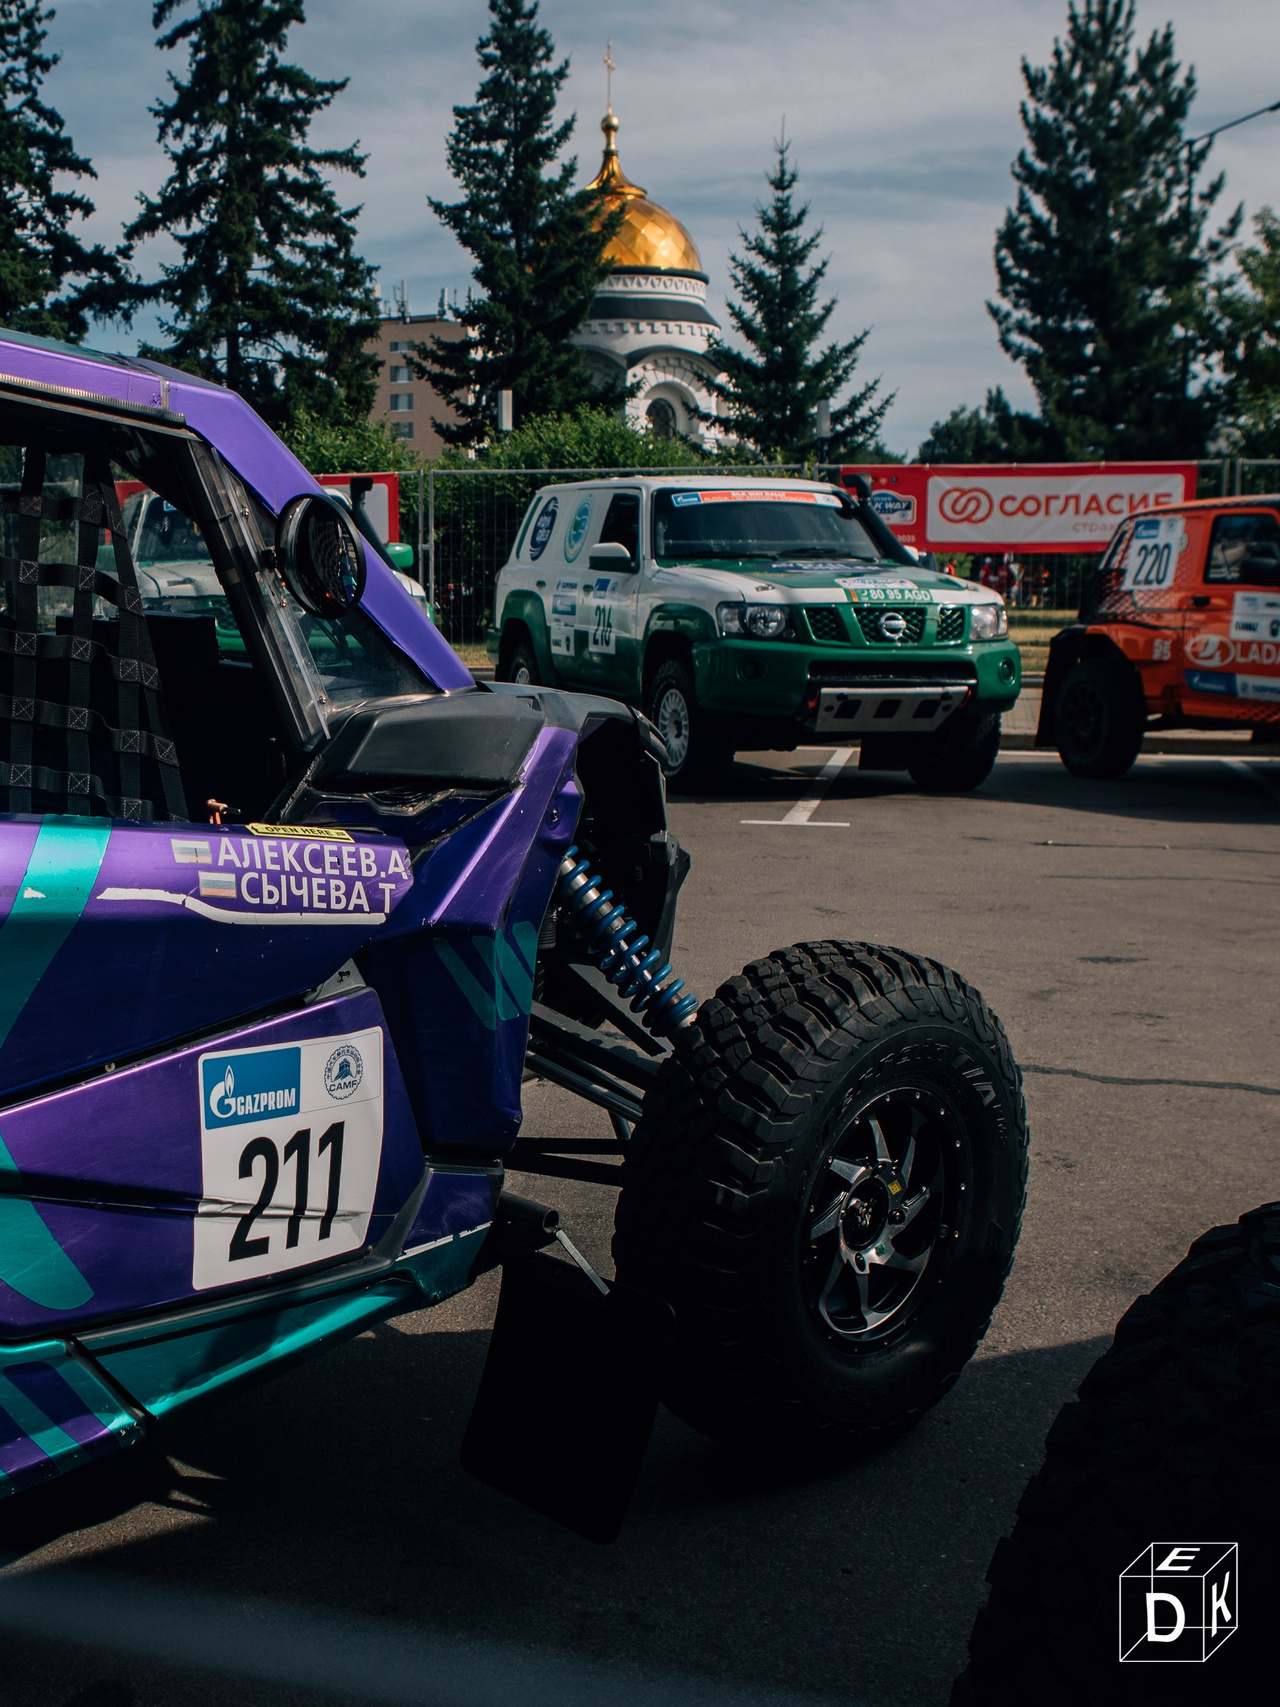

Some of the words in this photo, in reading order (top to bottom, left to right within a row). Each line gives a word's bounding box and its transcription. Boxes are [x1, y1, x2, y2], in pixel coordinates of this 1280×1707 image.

[998, 492, 1173, 517] СОГЛАСИЕ
[1133, 542, 1172, 586] 220
[869, 589, 885, 600] 80
[886, 589, 902, 600] 95
[593, 605, 613, 647] 216
[265, 826, 300, 834] OPEN
[301, 828, 334, 836] HERE
[240, 872, 370, 912] СЫЧЕВА
[329, 1079, 358, 1092] CAMF
[236, 1088, 296, 1116] GAZPROM
[228, 1120, 345, 1262] 211
